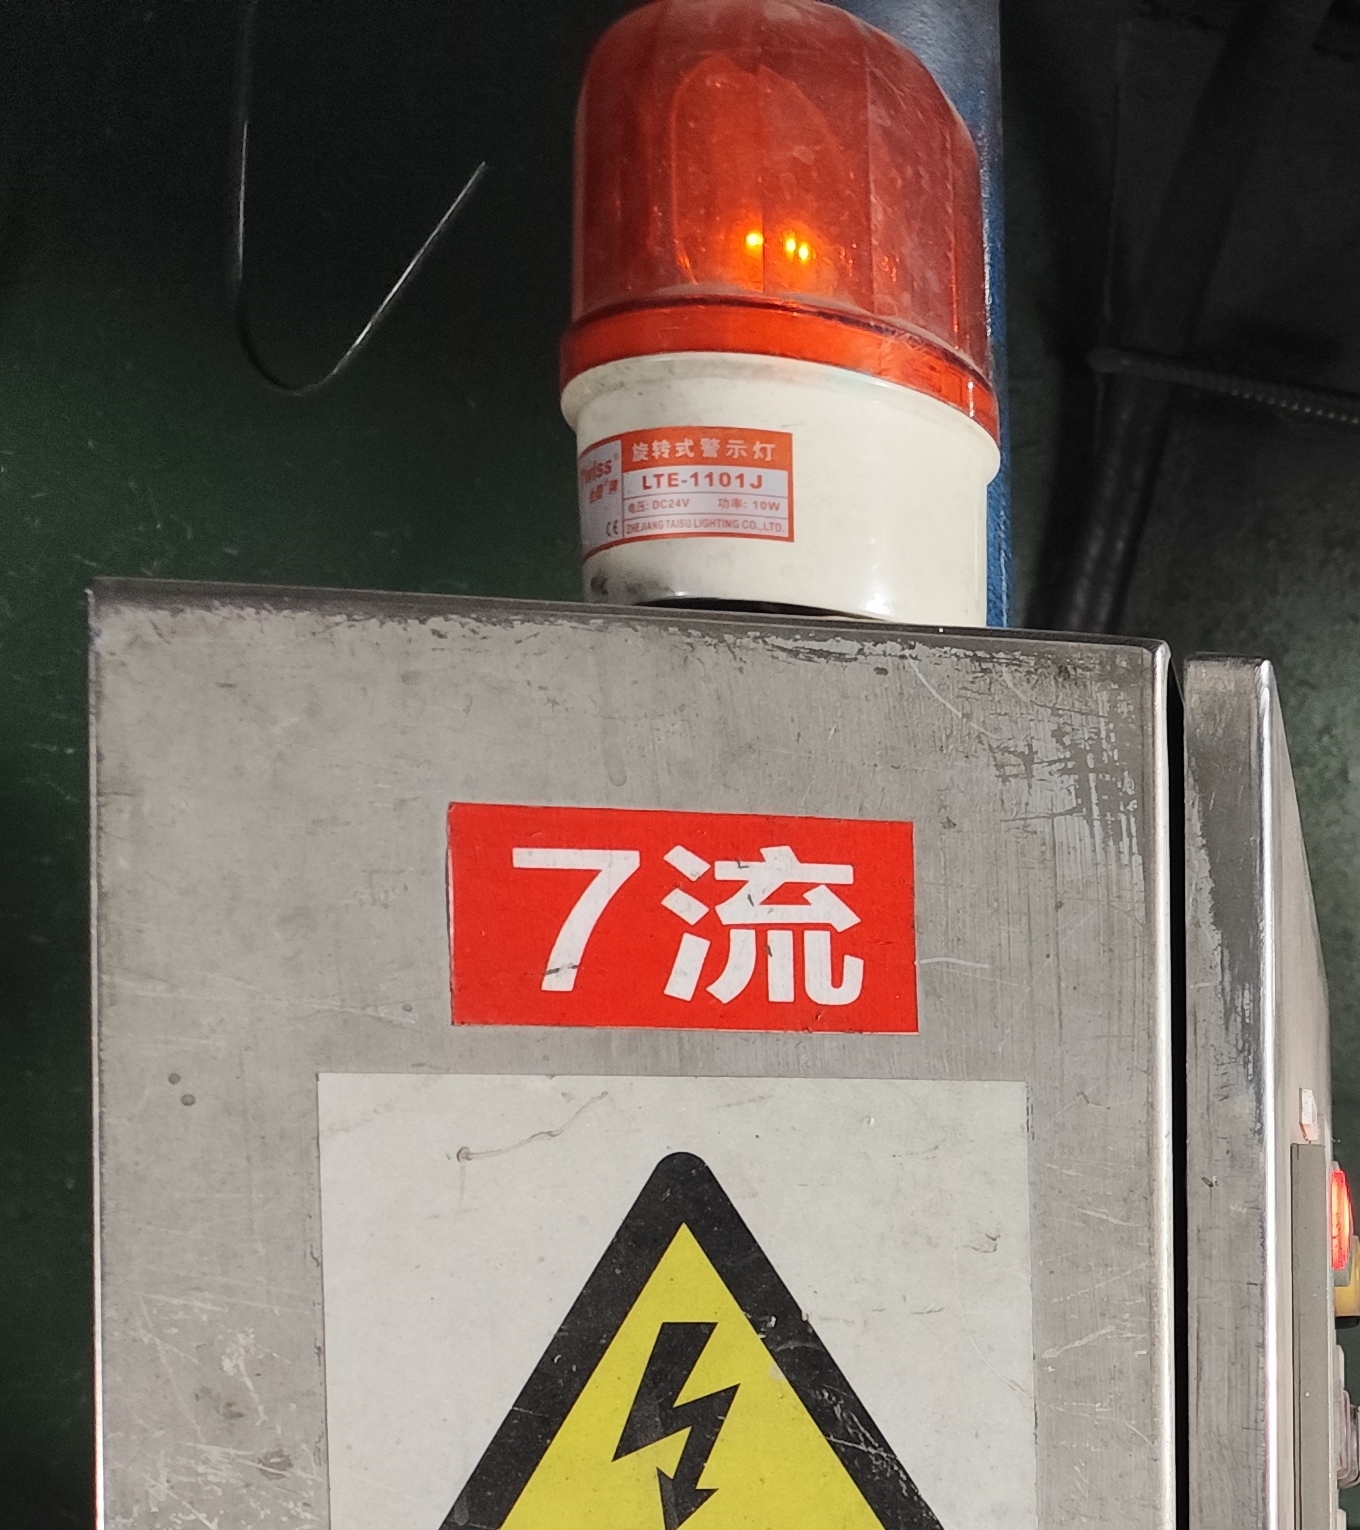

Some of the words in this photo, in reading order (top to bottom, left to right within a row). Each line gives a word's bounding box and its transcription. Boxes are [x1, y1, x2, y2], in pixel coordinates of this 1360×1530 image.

[631, 438, 776, 462] 旋转式警示灯
[642, 472, 763, 491] LTE-1101J
[652, 499, 690, 510] DC24V
[717, 498, 748, 510] 功率:
[752, 500, 781, 511] 10W
[665, 520, 692, 529] TAISU
[693, 519, 740, 529] LIGHTING
[511, 843, 863, 1006] 7流
